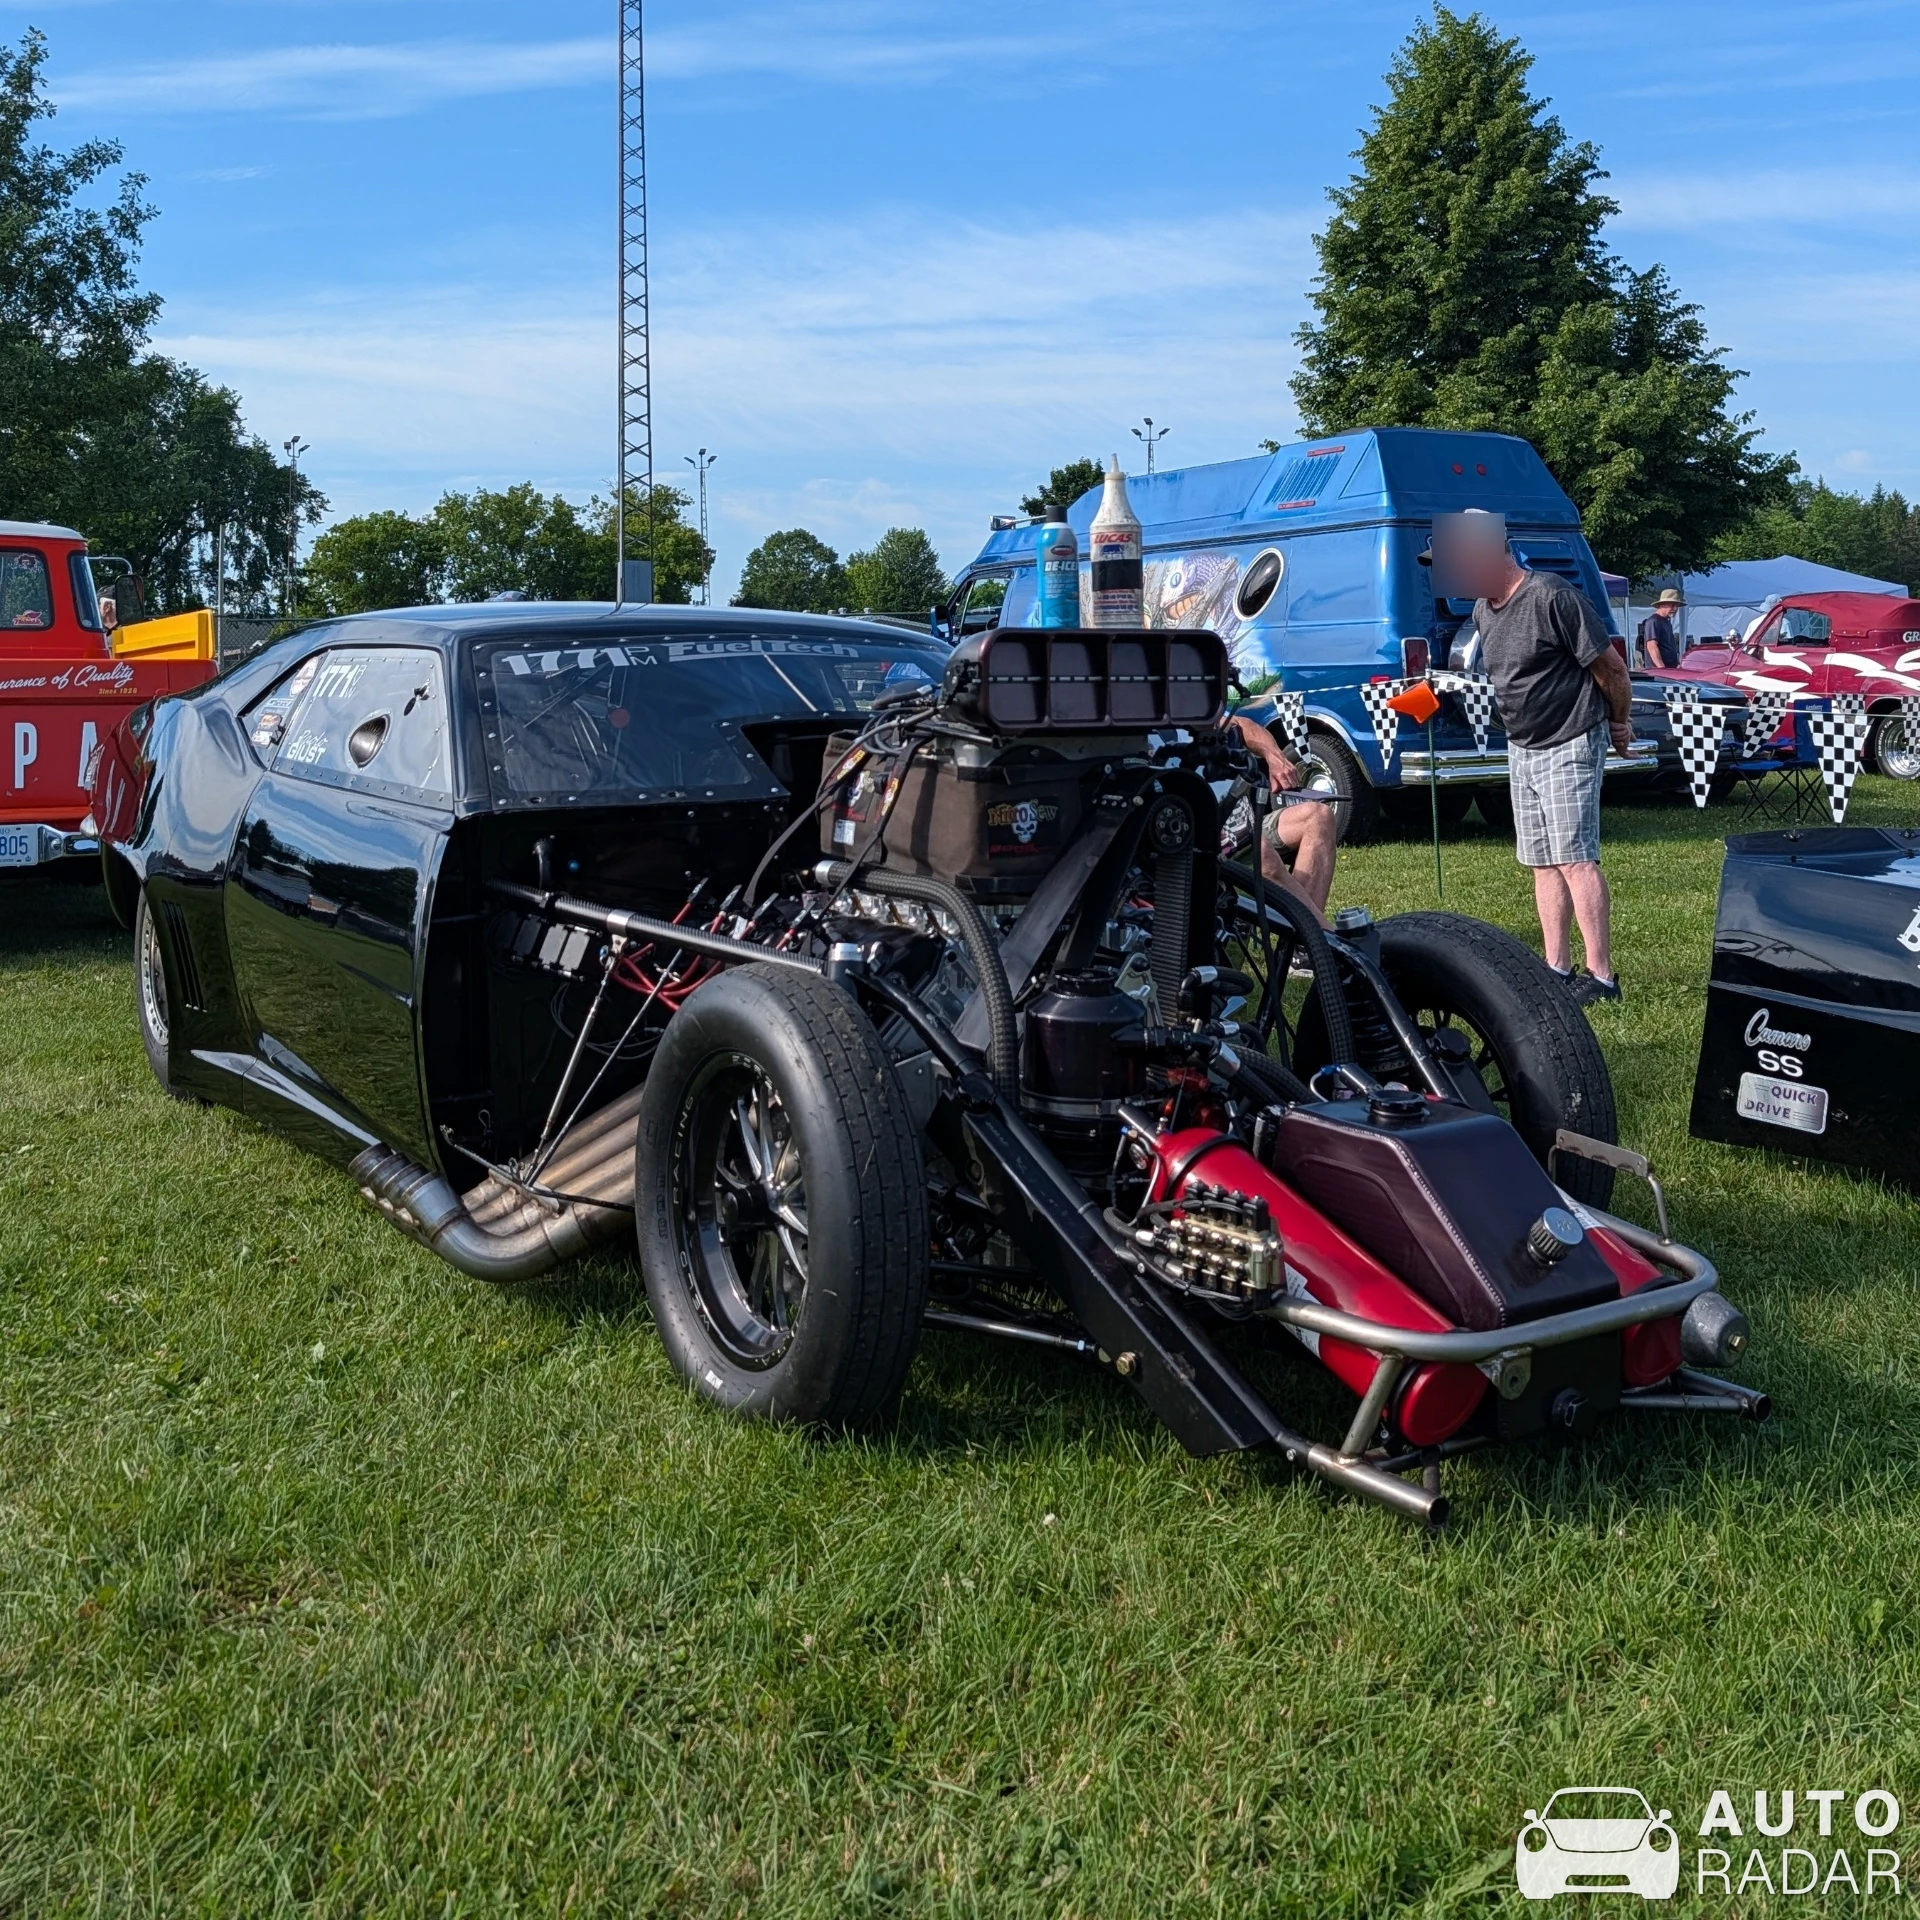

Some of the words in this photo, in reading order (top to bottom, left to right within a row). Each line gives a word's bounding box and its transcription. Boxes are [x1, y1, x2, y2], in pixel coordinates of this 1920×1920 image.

[1094, 532, 1133, 545] LUCAS
[501, 647, 630, 676] 1771
[660, 639, 860, 659] FuelTech
[51, 666, 74, 689] of
[74, 661, 134, 688] Quality
[312, 664, 360, 698] 1771
[1744, 1007, 1811, 1052] Camaro
[1757, 1049, 1803, 1077] SS
[1745, 1098, 1792, 1119] DRIVE
[1771, 1085, 1817, 1106] QUICK
